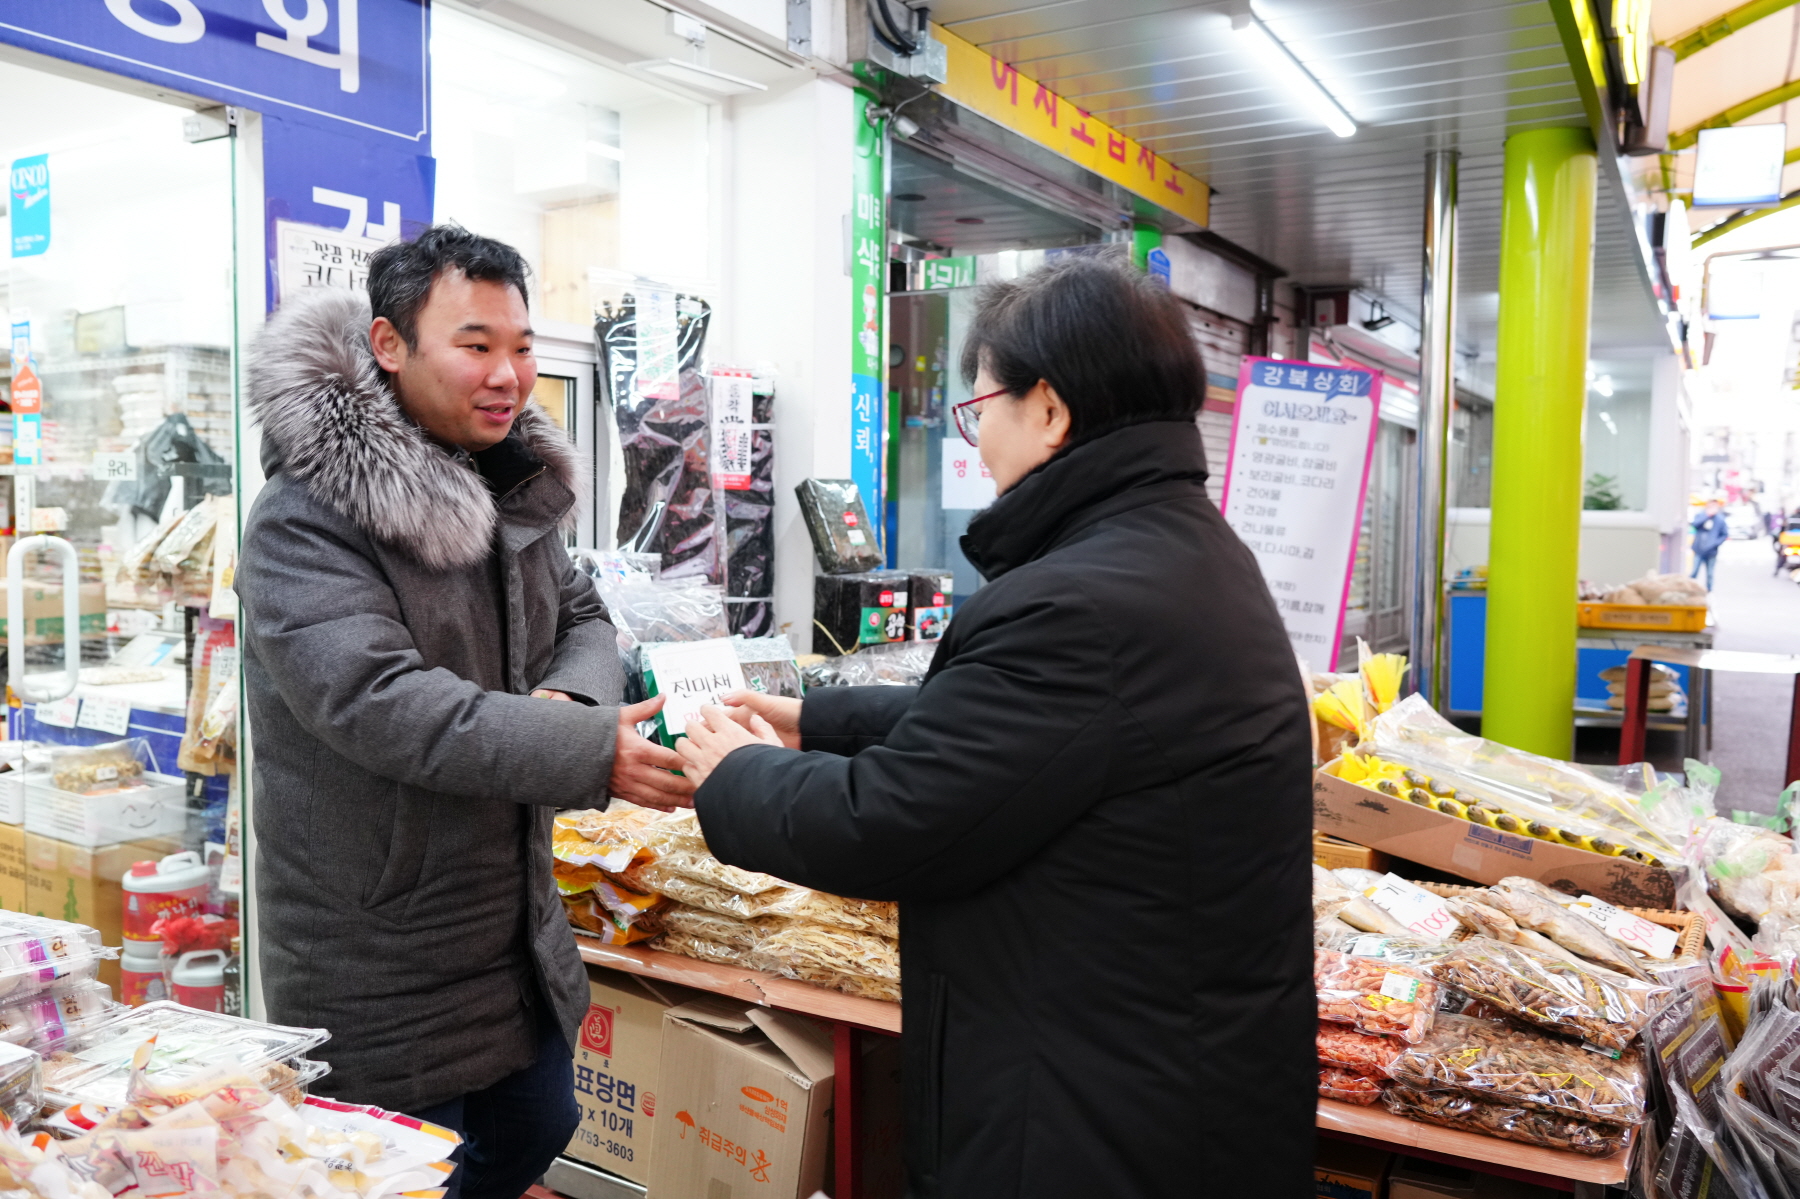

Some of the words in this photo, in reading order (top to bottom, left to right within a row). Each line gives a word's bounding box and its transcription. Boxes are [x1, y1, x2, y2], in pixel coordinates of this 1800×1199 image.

[1264, 366, 1359, 395] 강북상회
[1246, 486, 1281, 500] 건어물
[671, 673, 732, 698] 진미채
[575, 1064, 635, 1113] 표당면
[601, 1109, 633, 1138] 10개
[699, 1126, 747, 1166] 취급주의
